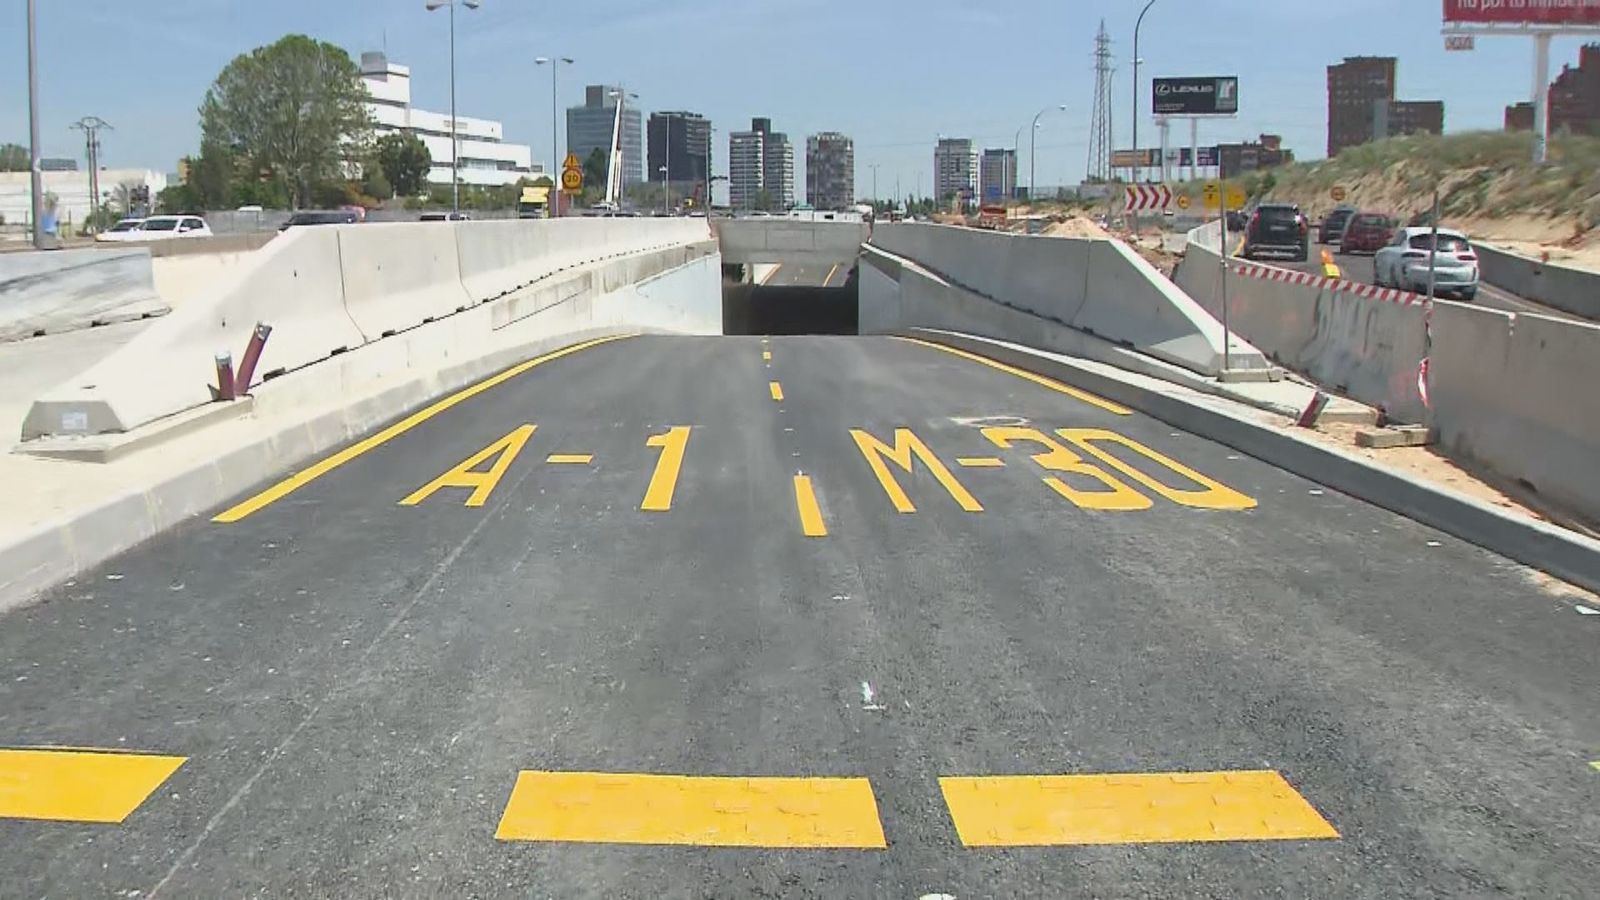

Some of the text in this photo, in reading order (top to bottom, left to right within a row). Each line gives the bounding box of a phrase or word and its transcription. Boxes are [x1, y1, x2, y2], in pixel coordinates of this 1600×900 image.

[1172, 85, 1214, 93] LEXUS
[397, 423, 692, 512] A-1
[849, 427, 1259, 512] M-30
